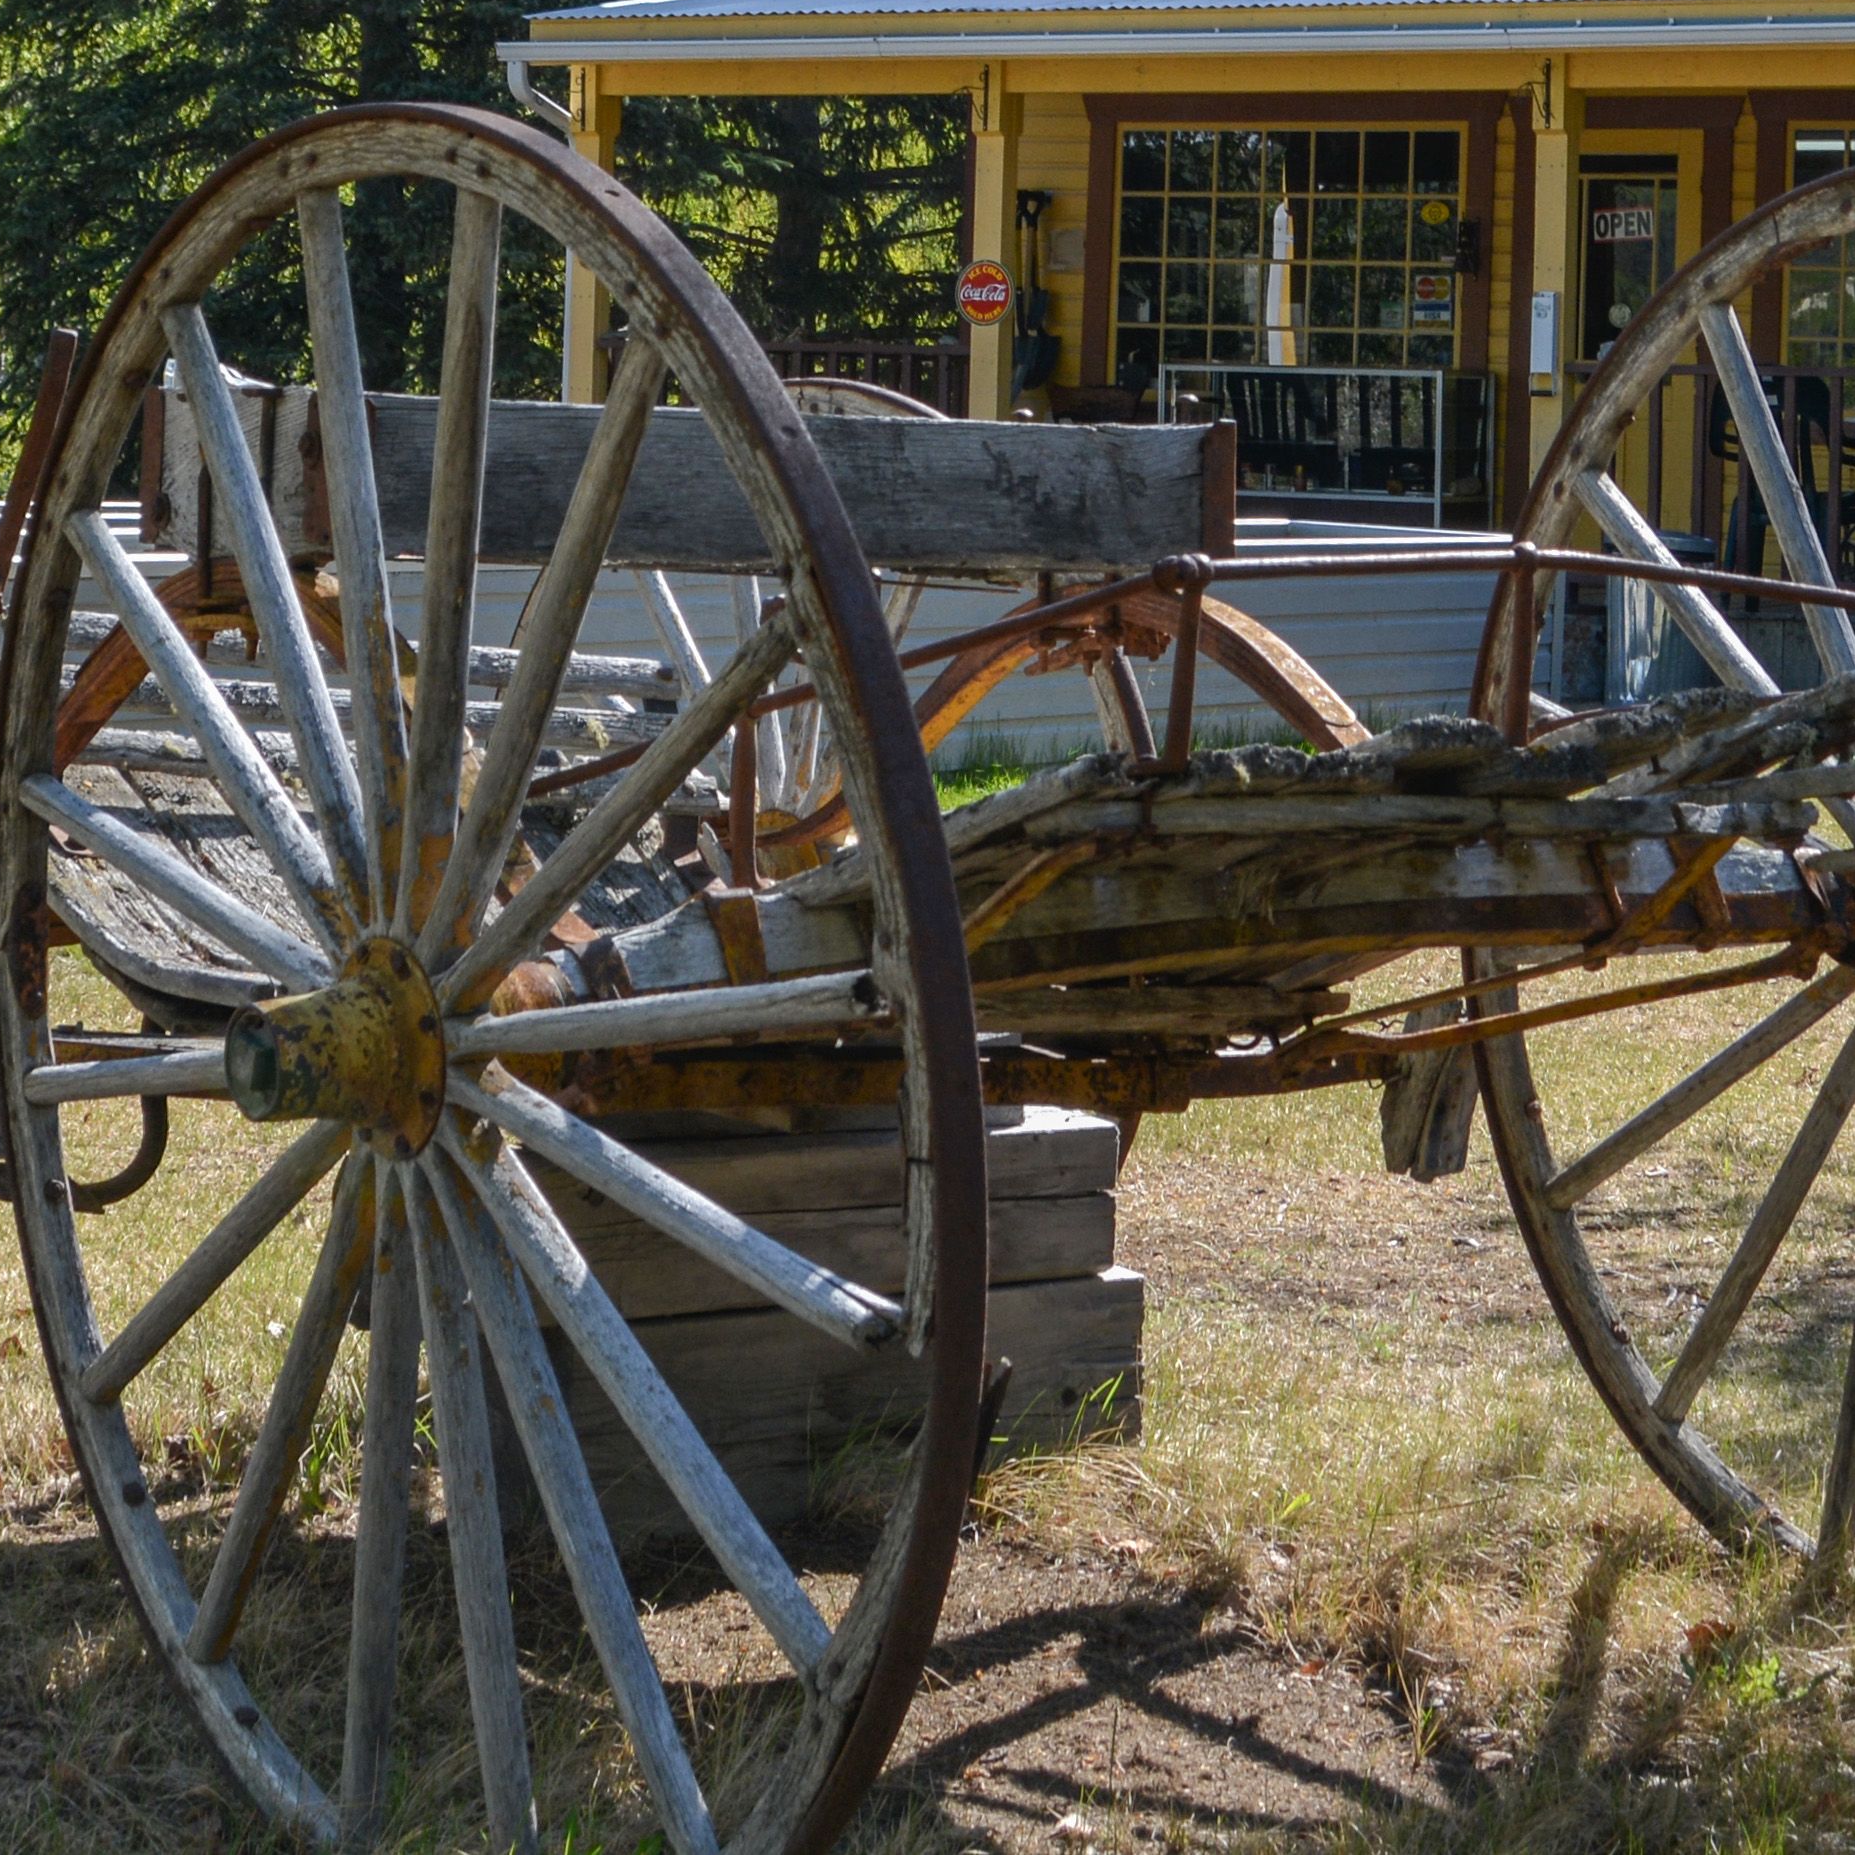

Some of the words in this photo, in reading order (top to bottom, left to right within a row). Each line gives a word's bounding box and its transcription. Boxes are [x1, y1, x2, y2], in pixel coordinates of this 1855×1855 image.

[1595, 211, 1651, 238] OPEN
[968, 266, 982, 280] ICE
[982, 265, 1004, 281] COLD
